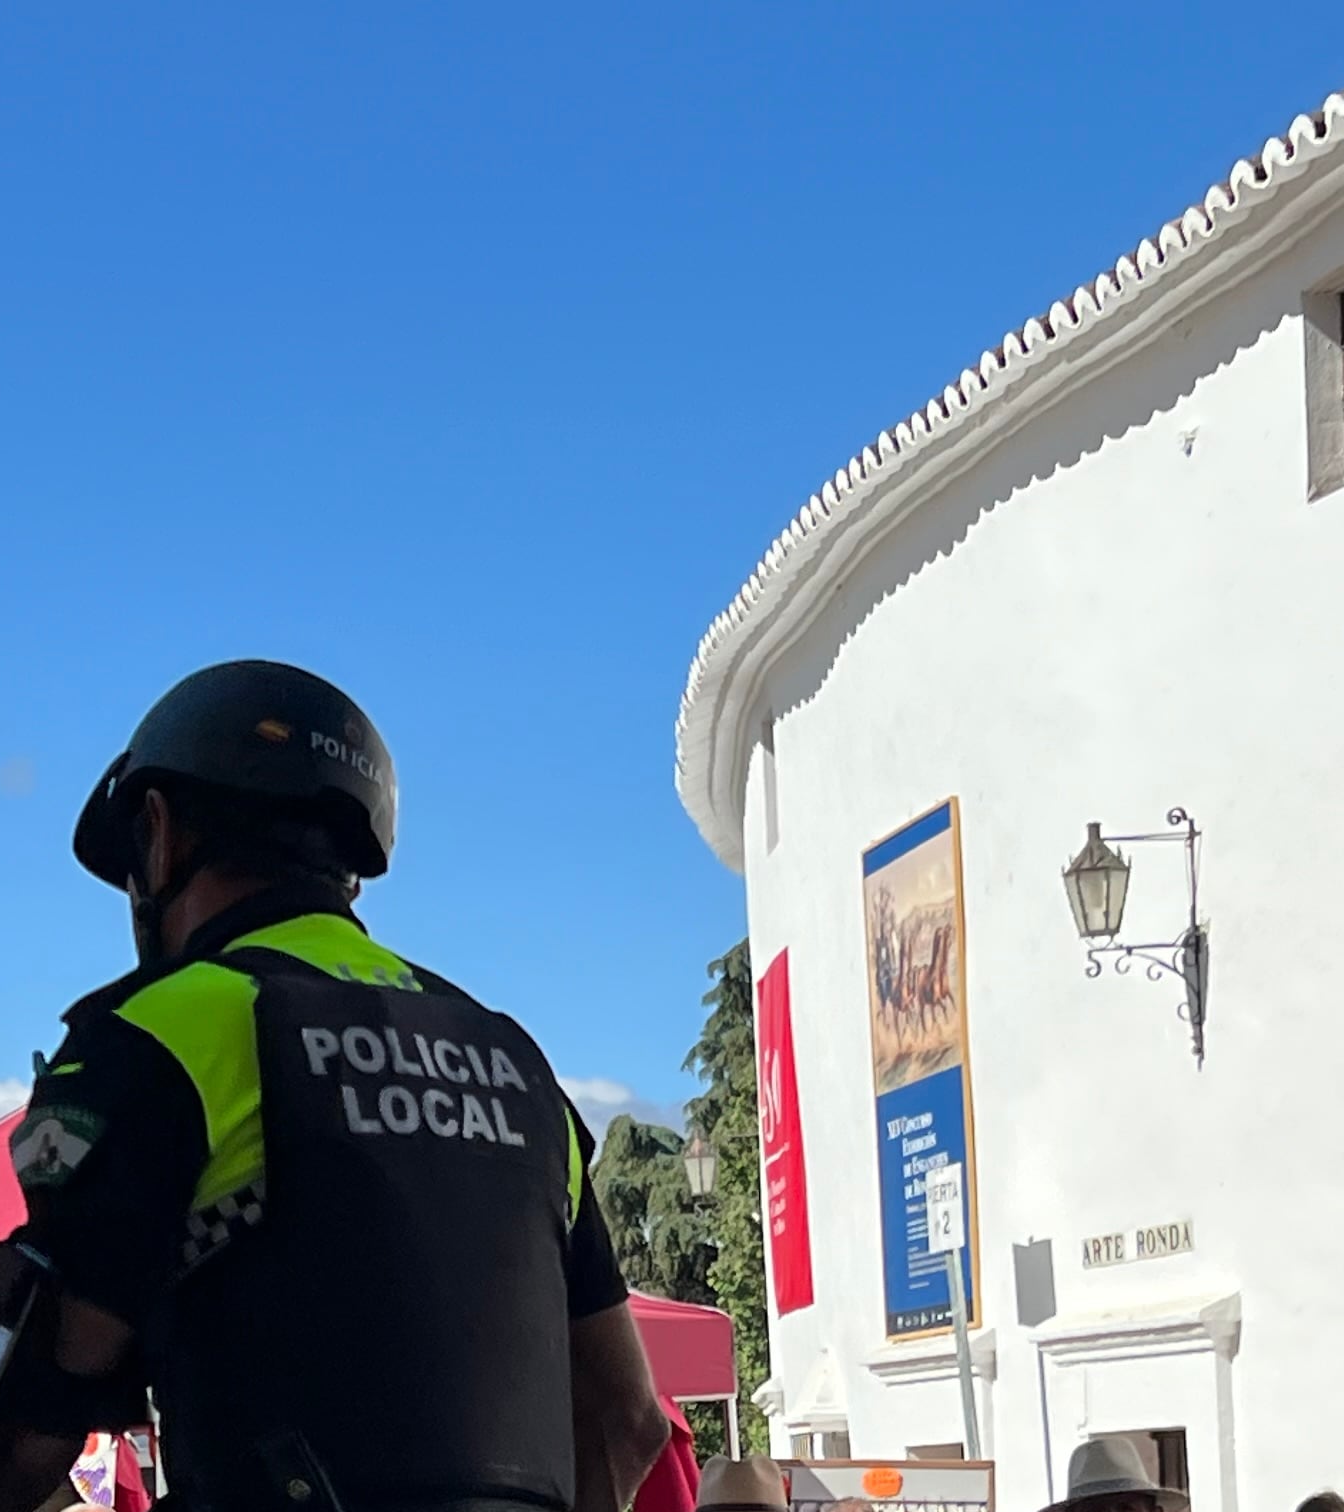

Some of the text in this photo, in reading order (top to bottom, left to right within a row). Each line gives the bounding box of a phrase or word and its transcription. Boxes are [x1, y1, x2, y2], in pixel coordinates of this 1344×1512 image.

[301, 1026, 528, 1092] POLICIA
[341, 1085, 525, 1147] LOCAL
[1083, 1222, 1192, 1265] ARTE RONDA
